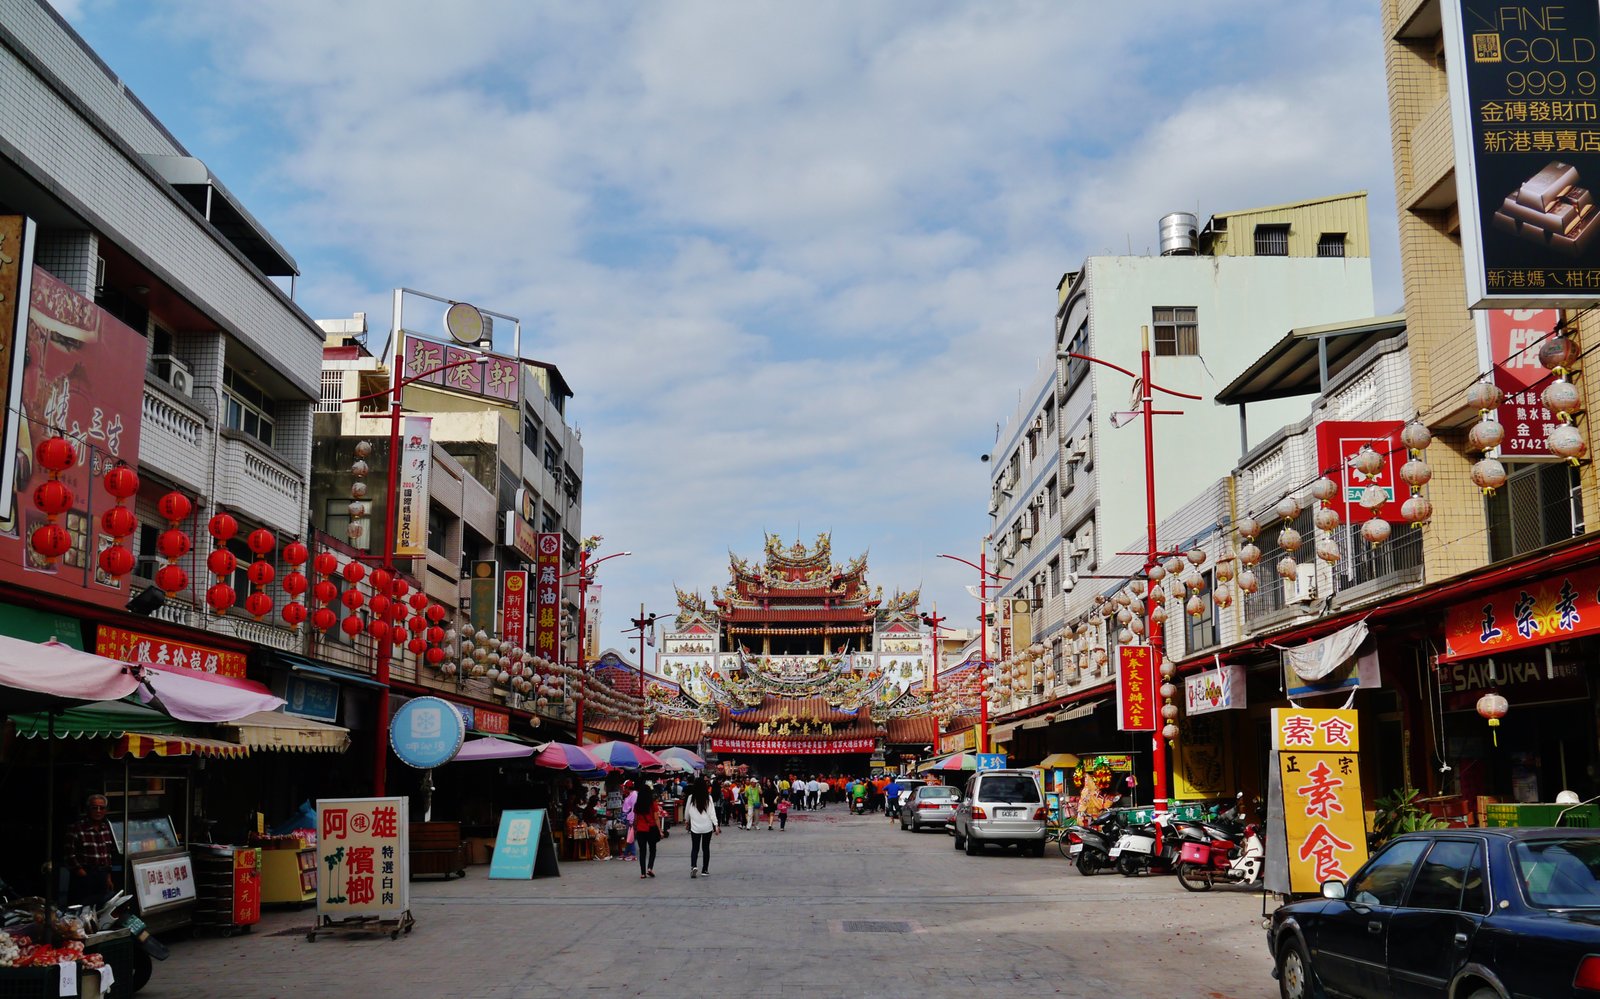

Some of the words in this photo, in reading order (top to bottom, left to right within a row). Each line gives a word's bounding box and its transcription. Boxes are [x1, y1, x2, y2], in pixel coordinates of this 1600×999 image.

[1500, 6, 1567, 31] FINE
[1503, 37, 1597, 63] GOLD
[1506, 70, 1597, 96] 999.9
[1481, 101, 1598, 122] 金磚發財巾
[1484, 130, 1600, 152] 新港專賣店
[407, 340, 517, 400] 新港軒
[1516, 407, 1551, 420] 熱水器
[1480, 578, 1600, 643] 正宗素
[1127, 657, 1145, 727] 奉天宮辦公室
[1283, 715, 1354, 746] 素食
[1286, 755, 1354, 776] 正宗
[1297, 760, 1354, 884] 素食
[345, 846, 375, 906] 檳榔
[381, 846, 394, 905] 特選白肉
